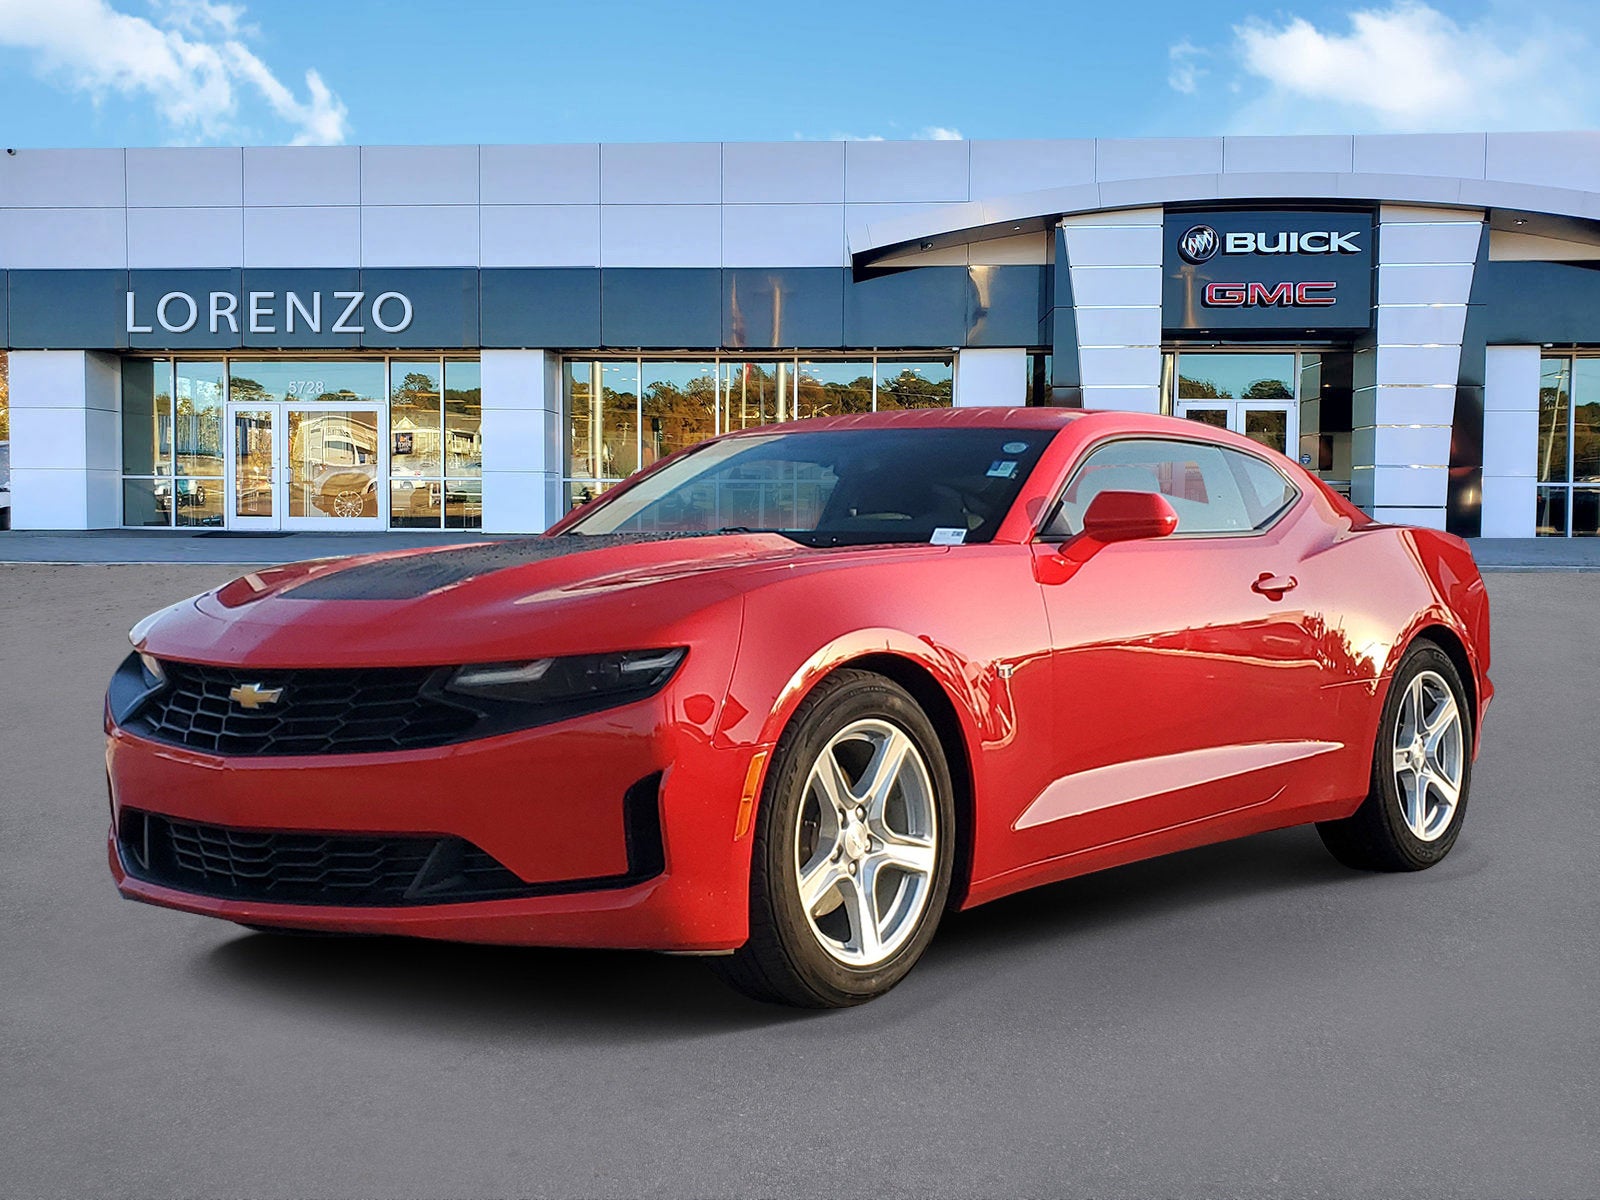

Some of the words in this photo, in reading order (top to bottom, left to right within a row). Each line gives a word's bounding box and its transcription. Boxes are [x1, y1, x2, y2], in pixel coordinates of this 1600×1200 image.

[1226, 231, 1362, 253] BUICK
[1206, 281, 1337, 305] GMC
[126, 291, 413, 333] LORENZO
[288, 381, 325, 394] 5728
